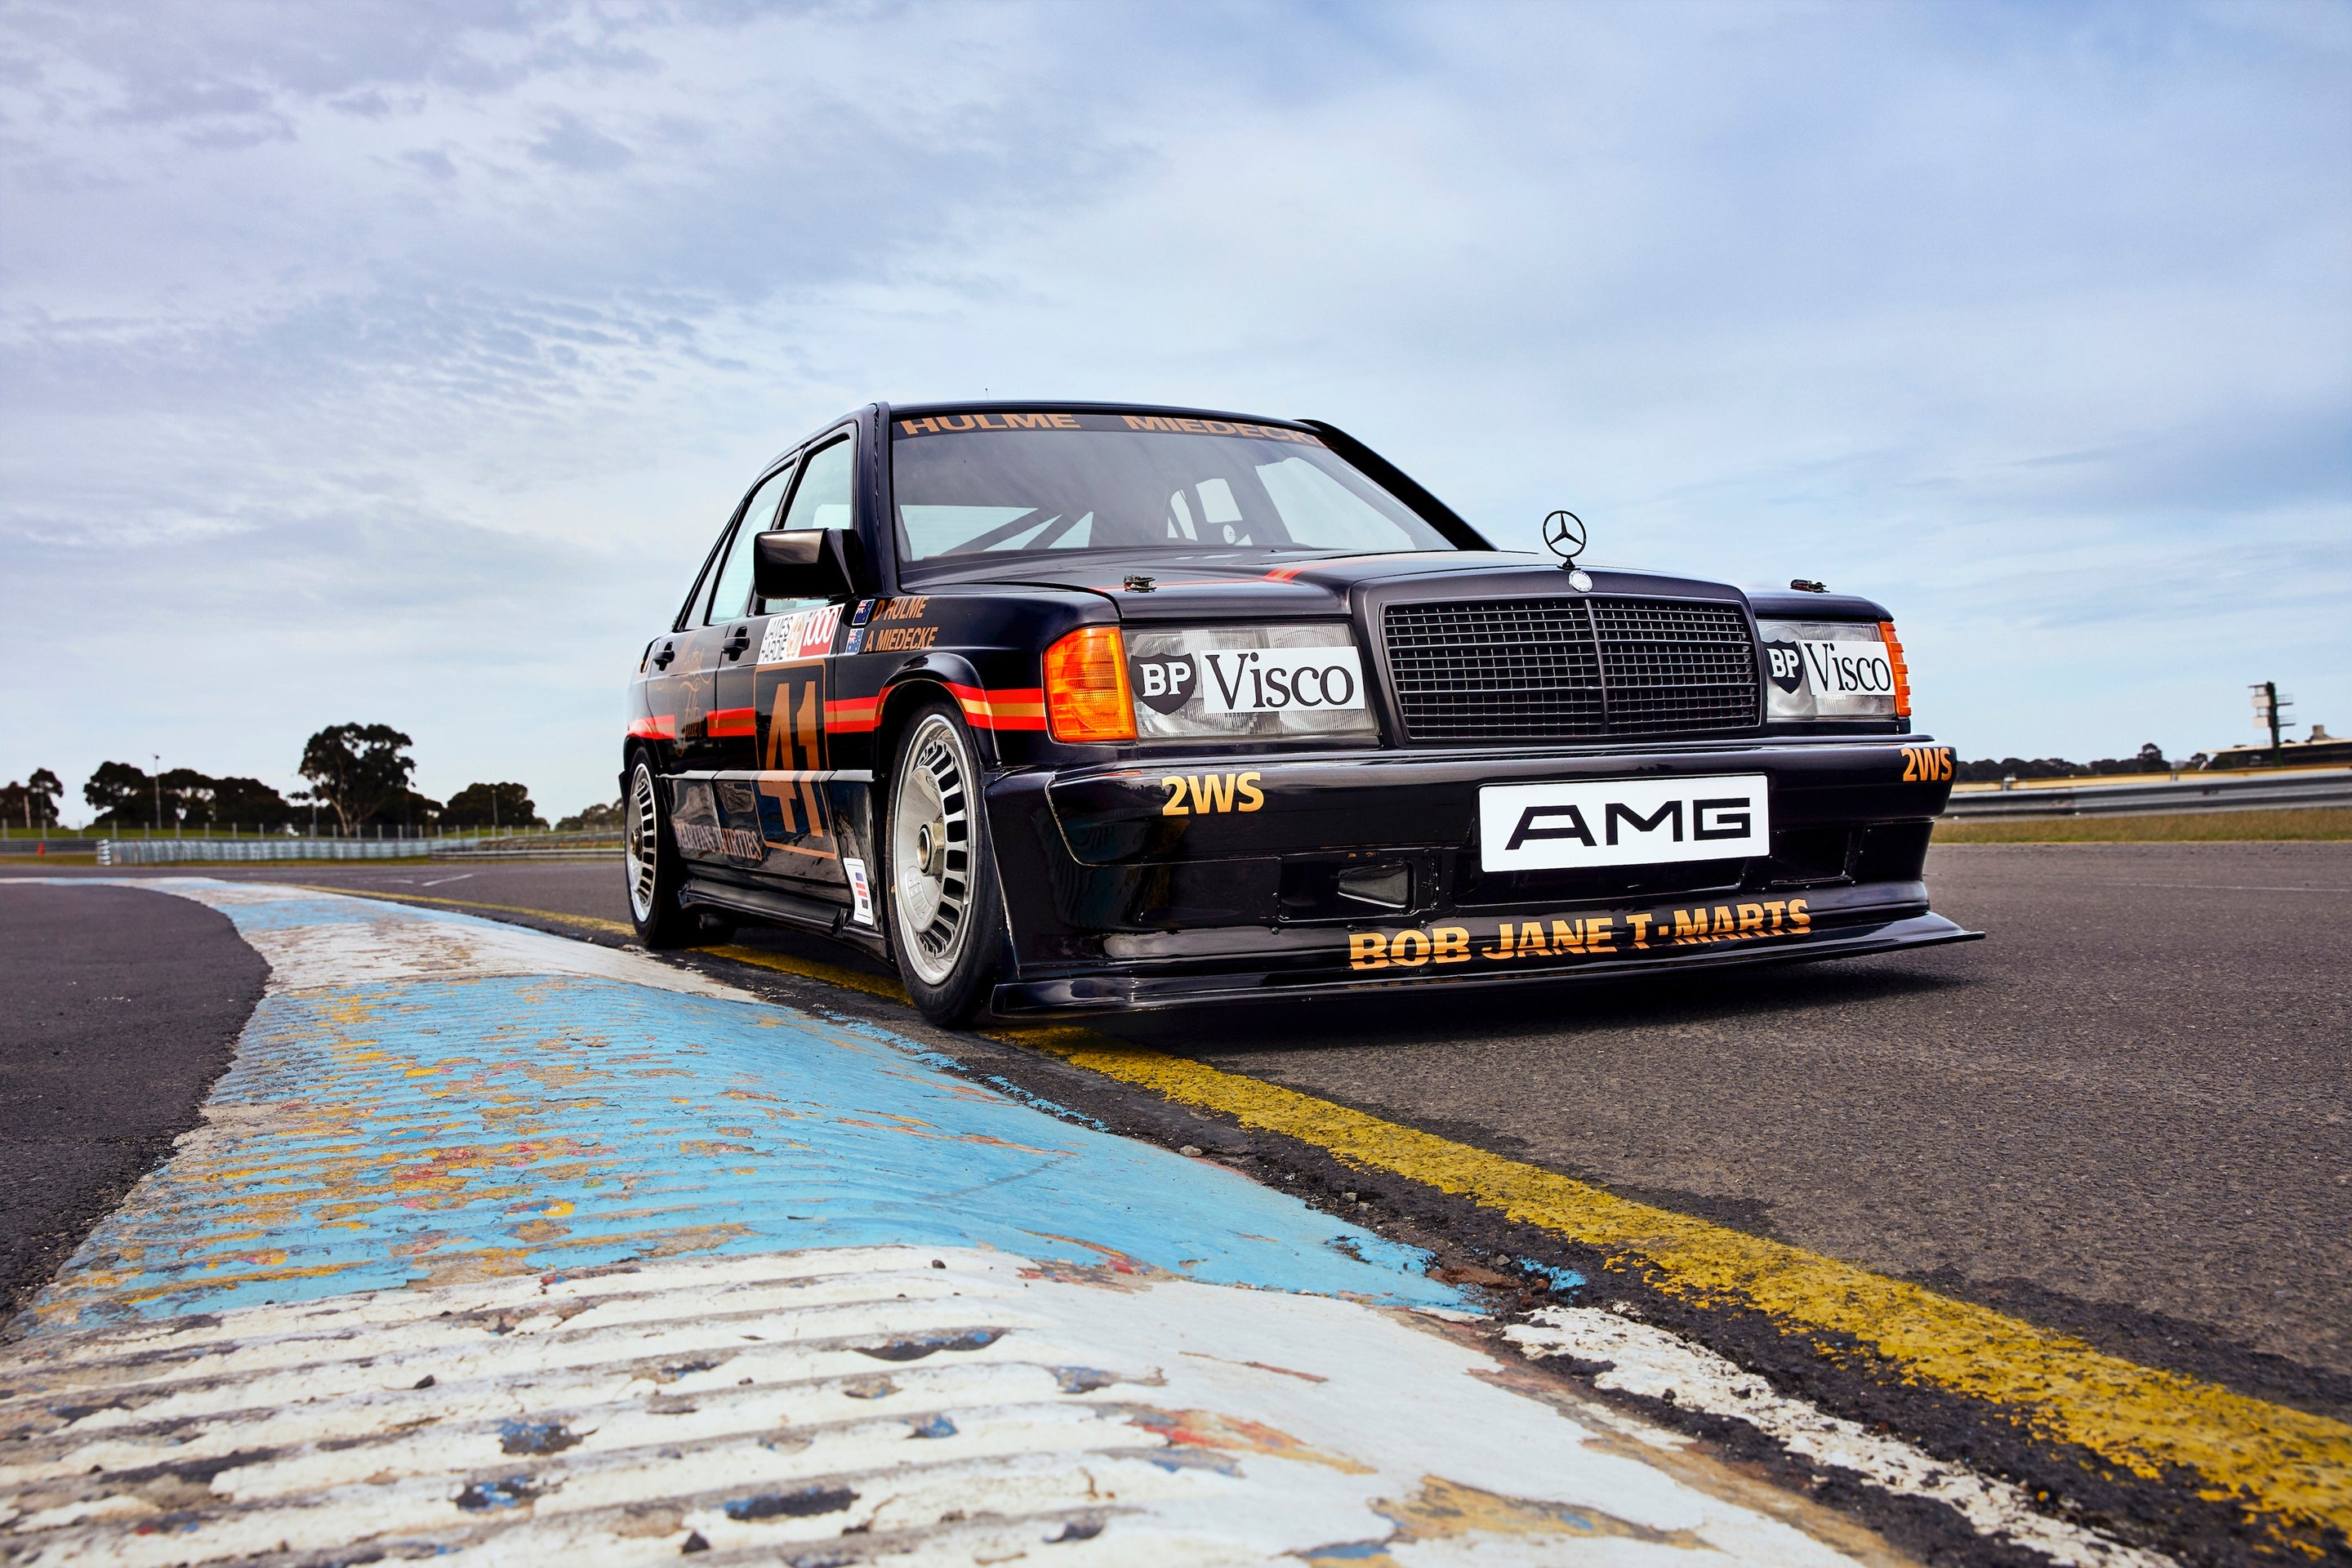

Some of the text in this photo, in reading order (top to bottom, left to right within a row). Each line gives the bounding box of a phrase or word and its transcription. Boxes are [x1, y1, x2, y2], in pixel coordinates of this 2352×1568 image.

[901, 414, 1081, 435] HULME
[803, 608, 838, 646] 1000
[872, 595, 930, 621] D HULME
[765, 615, 794, 641] JAMES
[864, 626, 939, 653] A MIEDECKE
[759, 637, 787, 664] HARDIE
[1766, 643, 1891, 692] BP Visco
[1138, 652, 1354, 710] BP Visco
[758, 681, 824, 838] 41
[1900, 746, 1953, 782] 2WS
[1161, 772, 1265, 816] 2WS
[1504, 797, 1751, 850] AMG
[1349, 927, 1471, 970] BOB
[1482, 917, 1616, 960] JANE
